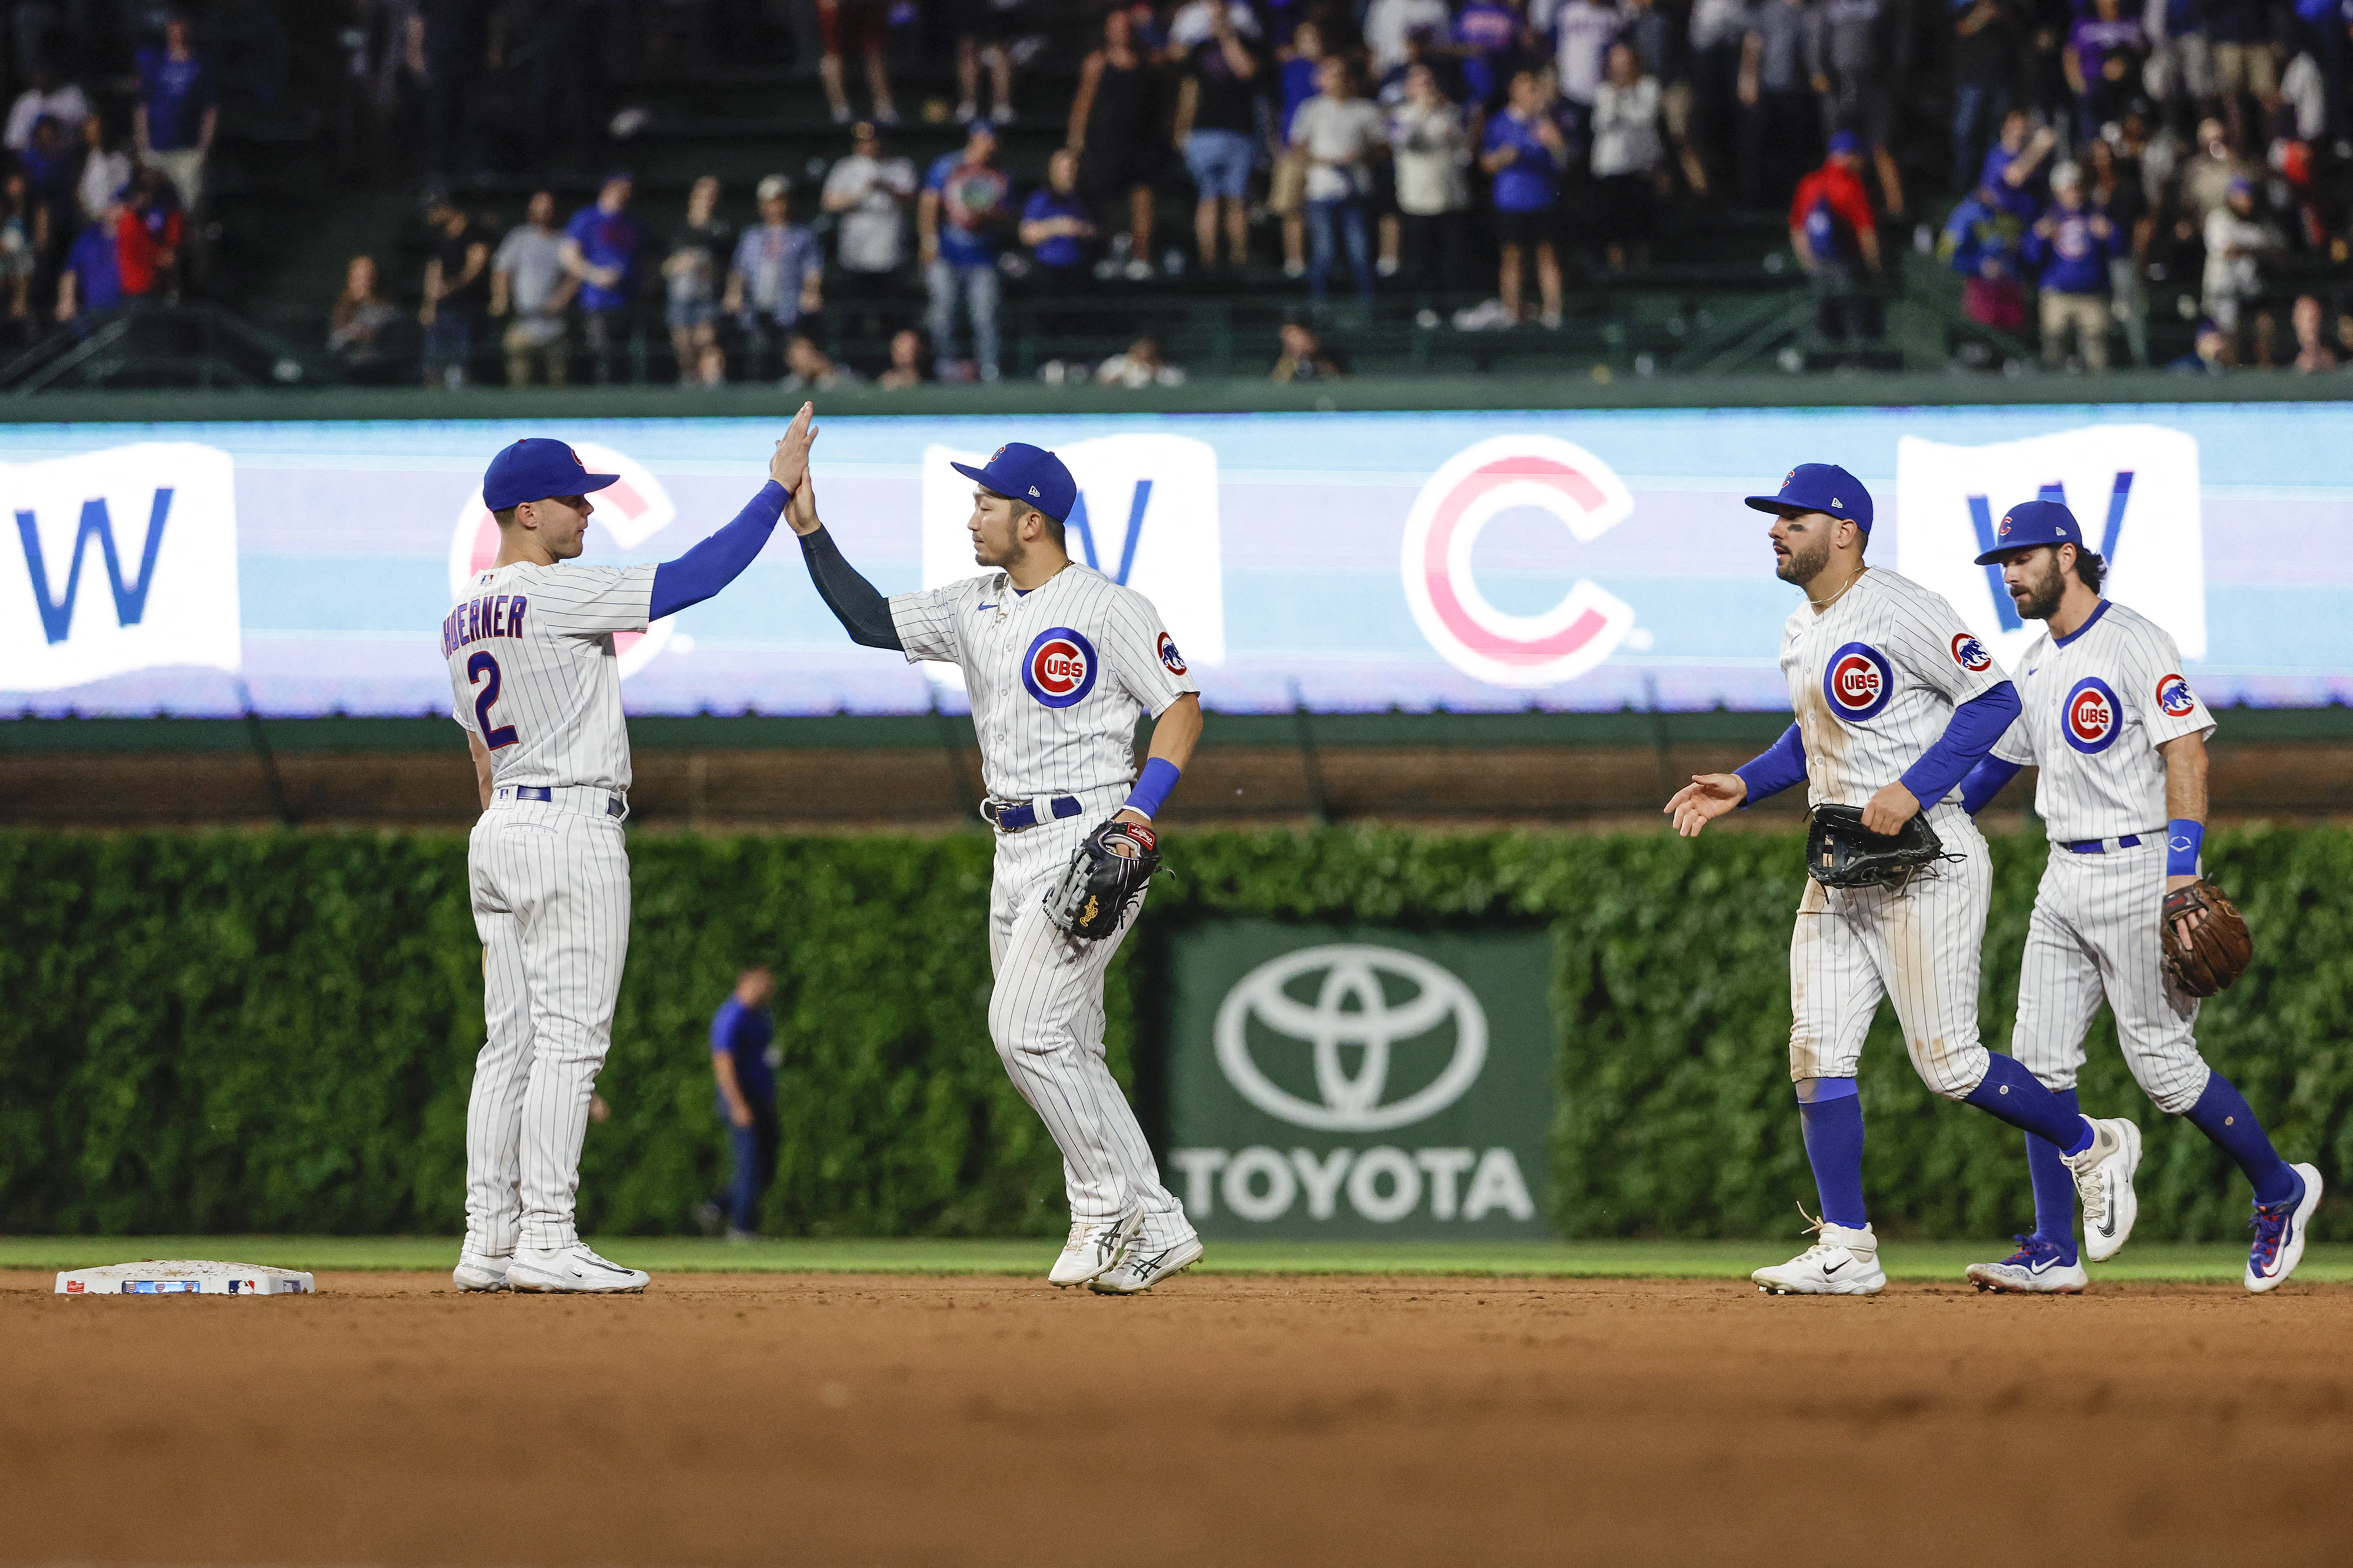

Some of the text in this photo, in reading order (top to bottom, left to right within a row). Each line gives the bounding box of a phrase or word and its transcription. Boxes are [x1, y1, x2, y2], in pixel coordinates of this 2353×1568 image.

[1401, 433, 1637, 687] C
[1999, 516, 2012, 536] C
[15, 485, 175, 646] W
[443, 595, 527, 660] HOERNER
[467, 650, 519, 751] 2
[1079, 894, 1099, 928] Rawlings
[1169, 1145, 1535, 1222] TOYOTA
